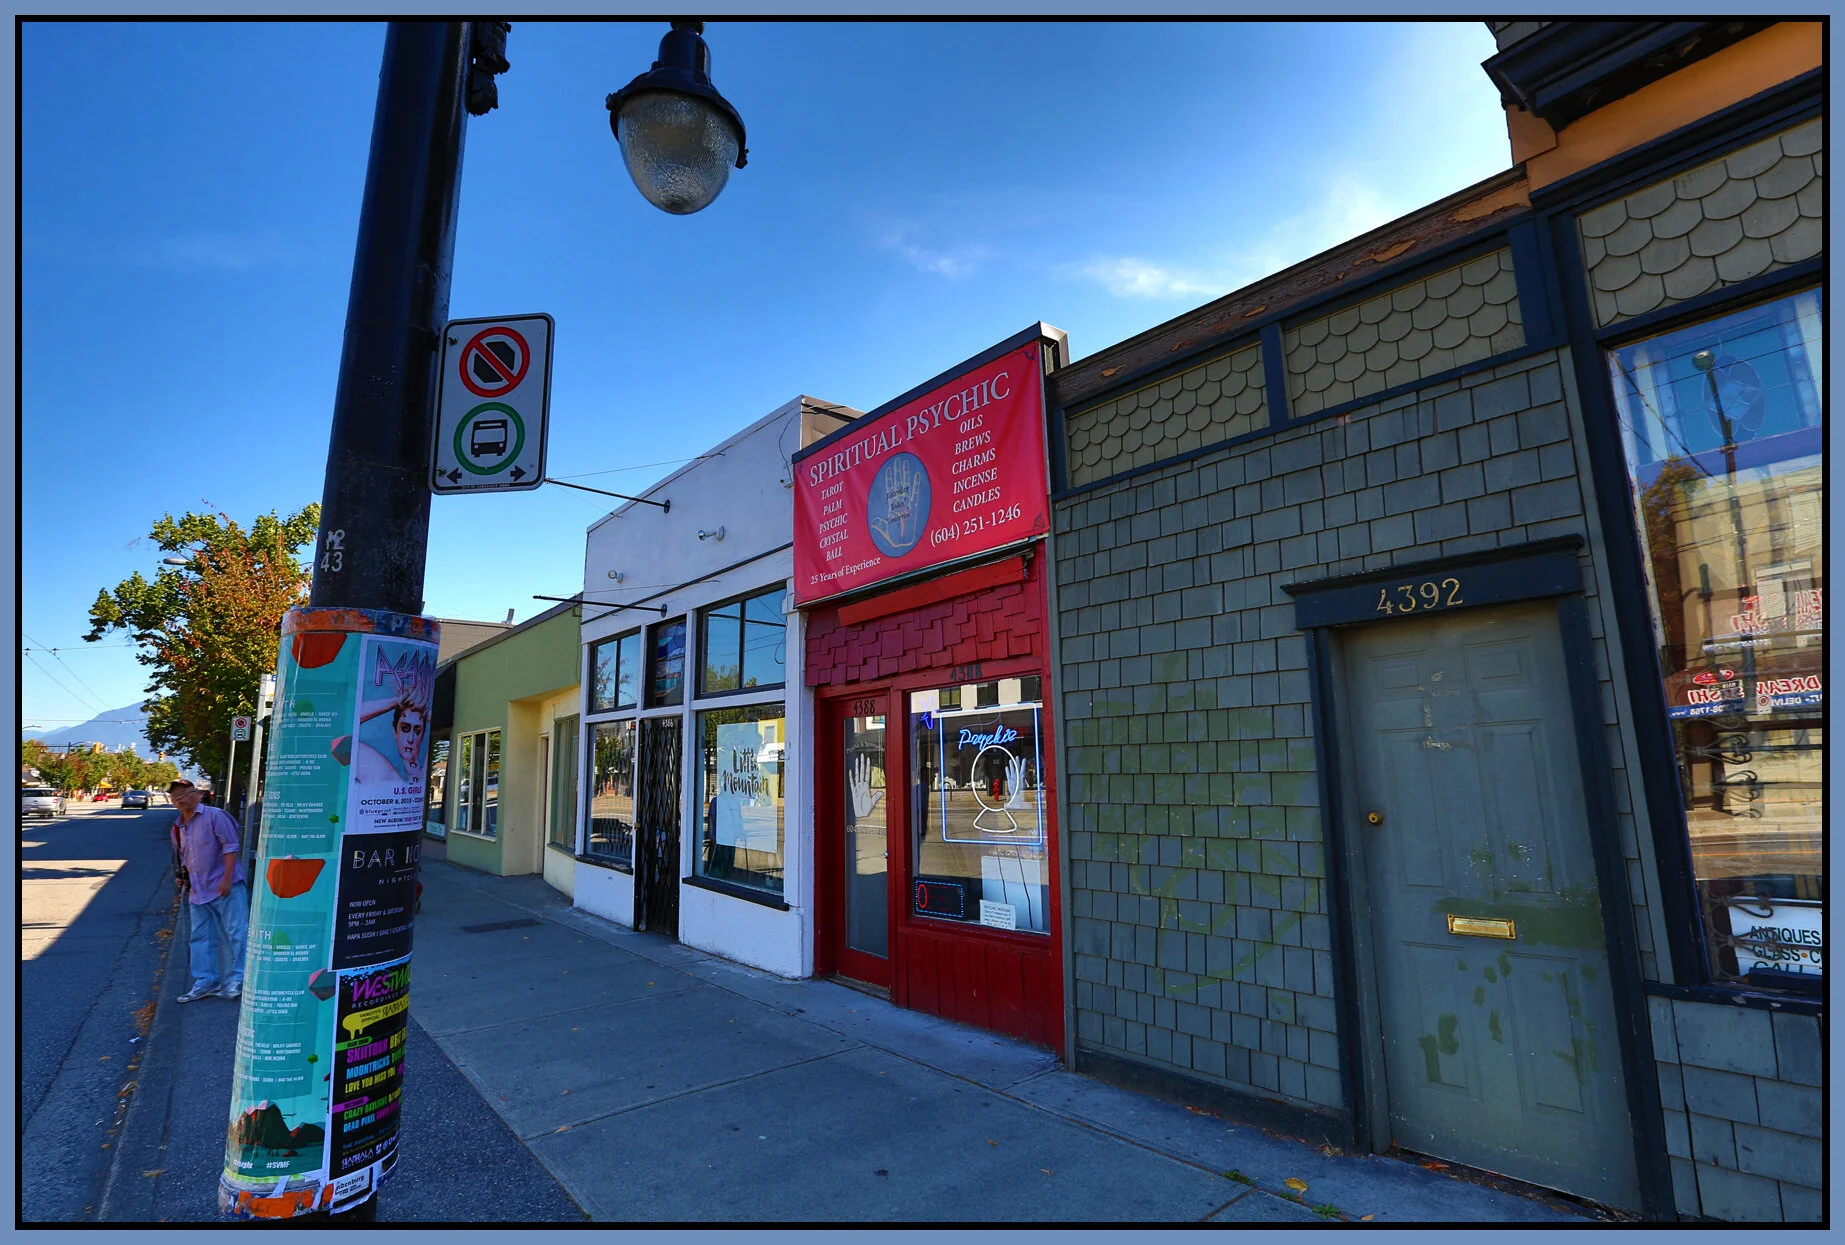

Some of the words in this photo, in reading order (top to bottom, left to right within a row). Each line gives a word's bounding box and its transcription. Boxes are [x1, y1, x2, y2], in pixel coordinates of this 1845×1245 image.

[810, 424, 903, 487] SPIRITUAL
[906, 372, 1010, 441] PSYCHIC
[959, 414, 983, 434] OILS
[954, 431, 992, 455] BREWS
[952, 448, 996, 475] CHARMS
[820, 481, 844, 500] TAROT
[953, 467, 998, 494] INCENSE
[823, 499, 842, 516] PALM
[953, 487, 1001, 513] CANDLES
[819, 513, 848, 534] PSYCHIC
[930, 523, 960, 547] (604)
[964, 503, 1021, 536] 251-1246
[820, 530, 848, 550] CRYSTAL
[320, 551, 343, 572] 43
[826, 546, 842, 562] BALL
[810, 574, 818, 585] 25
[820, 568, 838, 583] Years
[838, 564, 846, 578] of
[846, 556, 880, 575] Experience
[1376, 578, 1464, 614] 4392
[854, 699, 876, 715] 4388
[732, 746, 759, 774] Little
[722, 769, 769, 798] Mountain
[353, 848, 394, 868] BAR
[366, 910, 382, 918] FRIDAY
[1750, 926, 1821, 946] ANTIQUES
[345, 1081, 360, 1094] LOVE
[362, 1076, 373, 1088] YOU
[344, 1106, 364, 1120] CRAZY
[344, 1120, 360, 1132] DEAD
